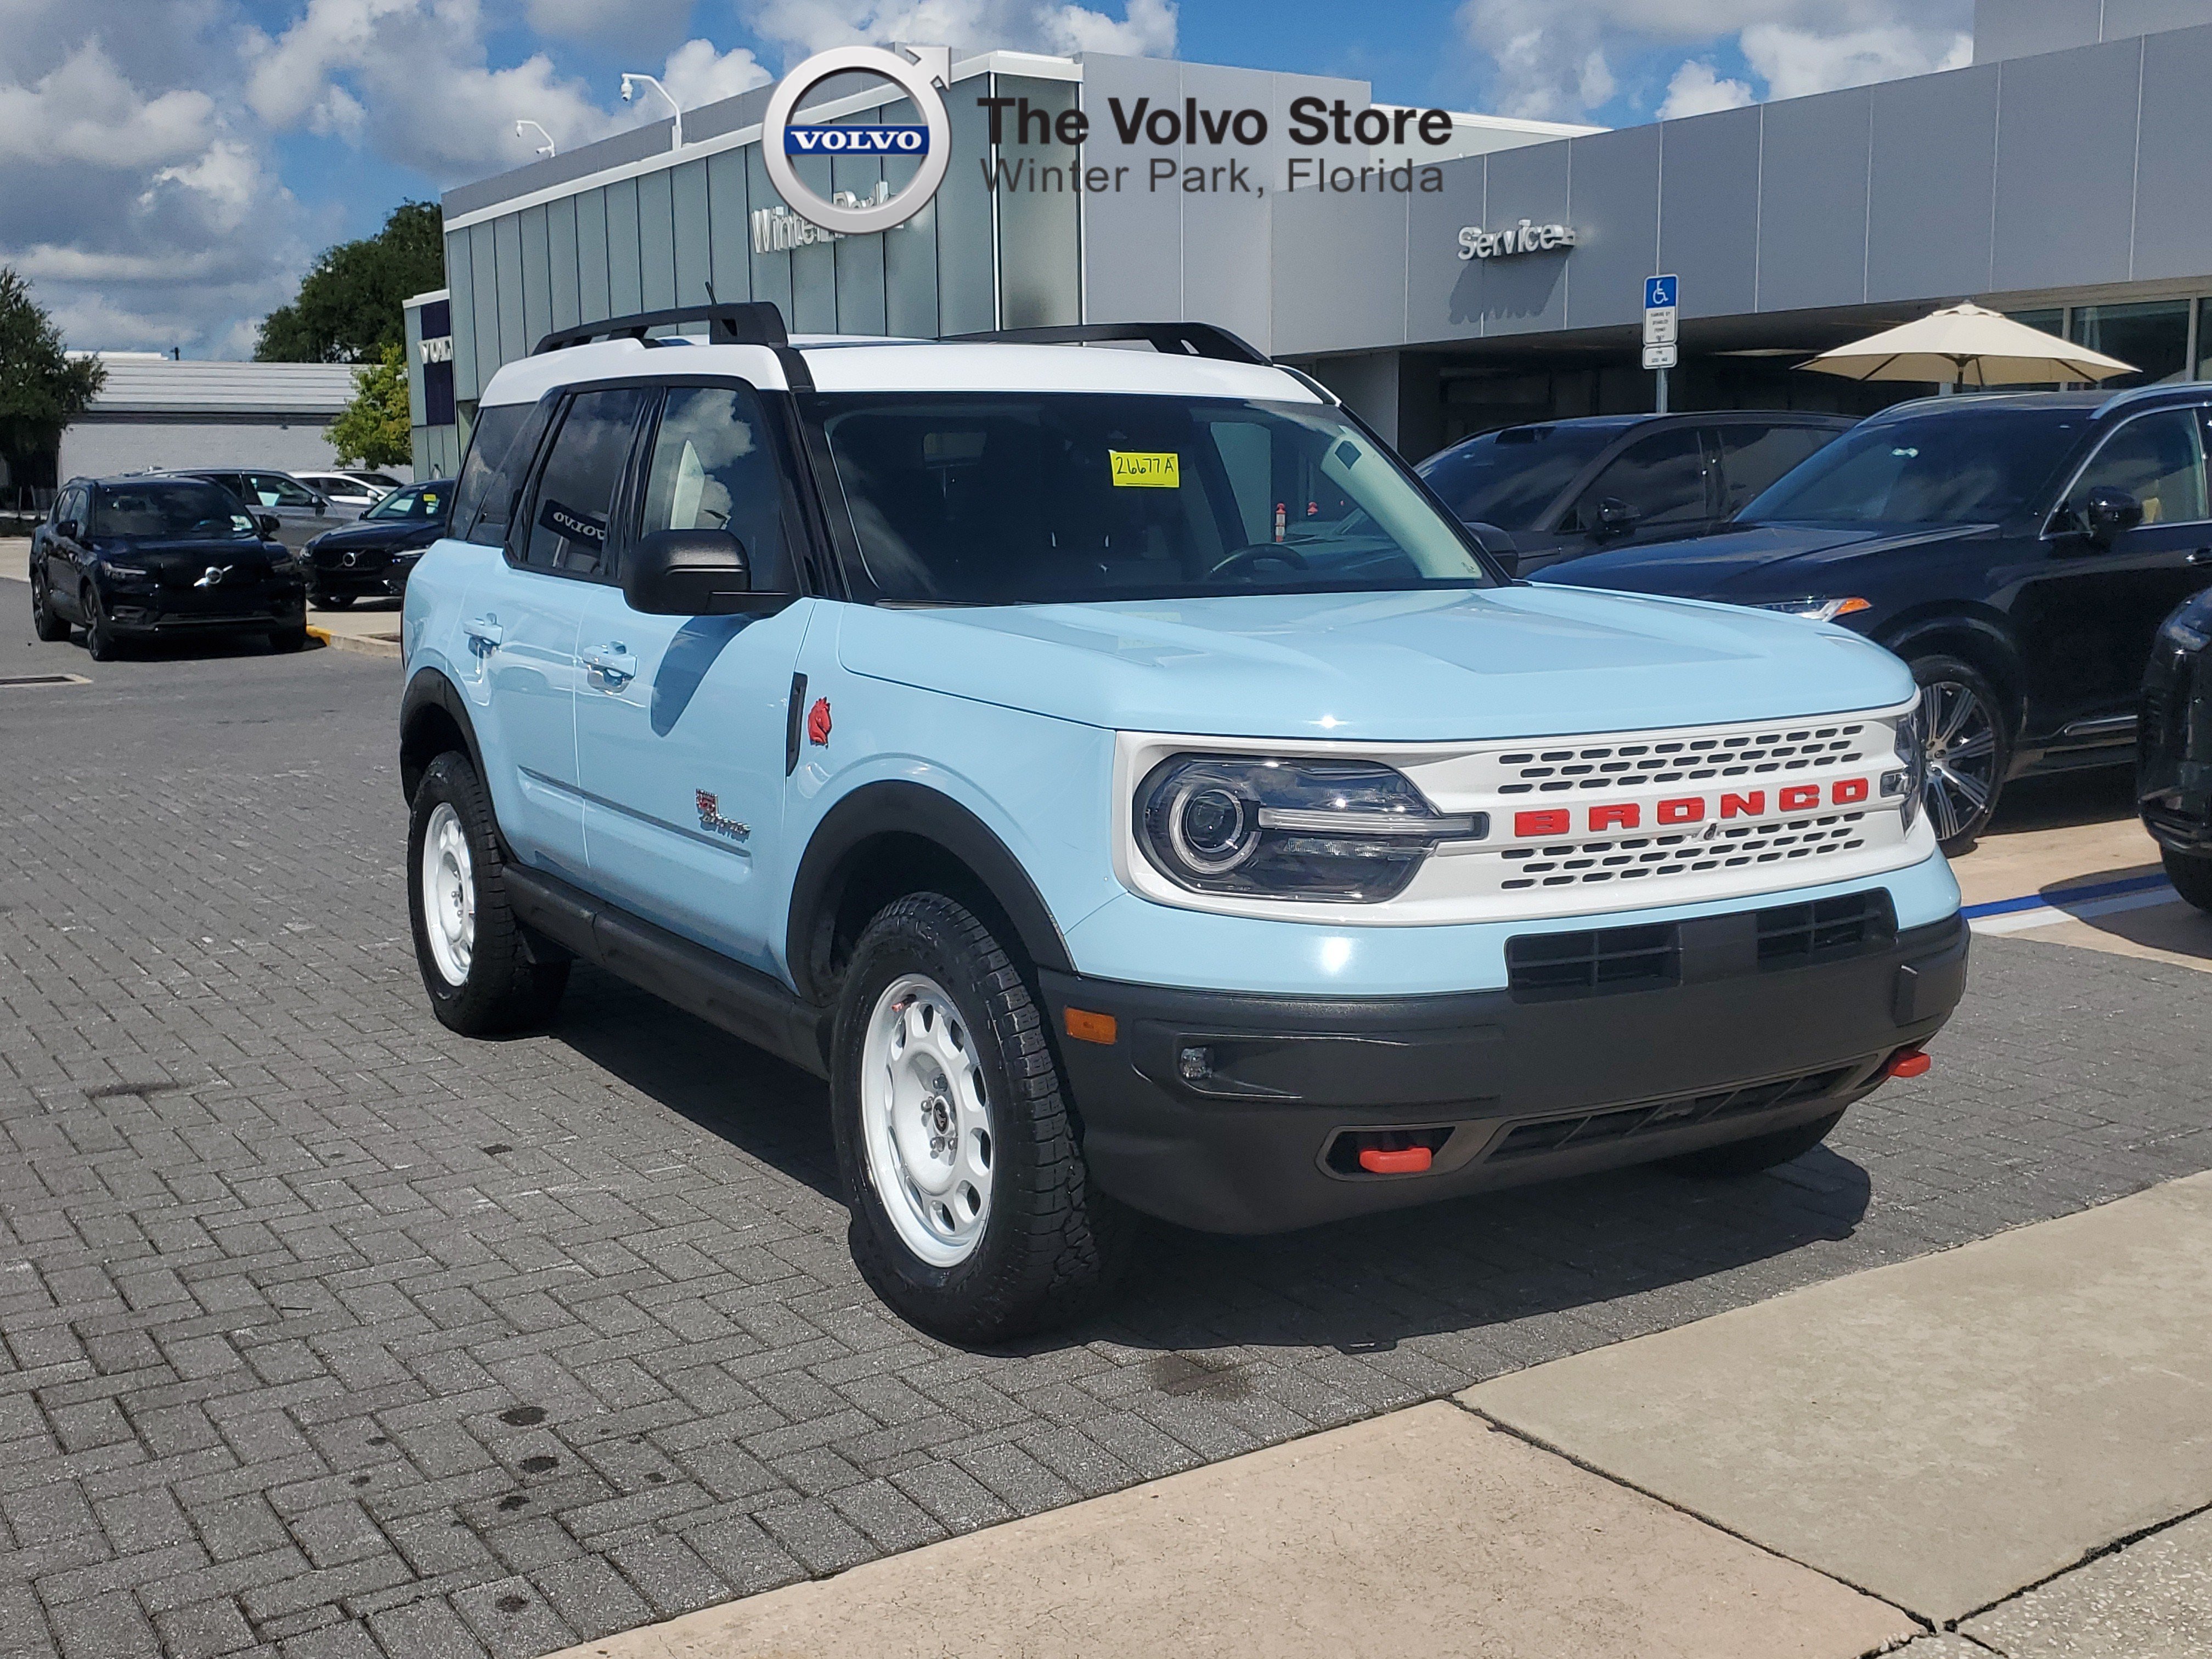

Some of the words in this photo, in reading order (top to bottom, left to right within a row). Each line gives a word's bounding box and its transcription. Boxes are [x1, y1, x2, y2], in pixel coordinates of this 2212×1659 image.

[1458, 219, 1576, 261] Service
[417, 336, 453, 364] VOL
[1514, 777, 1869, 837] BRONCO
